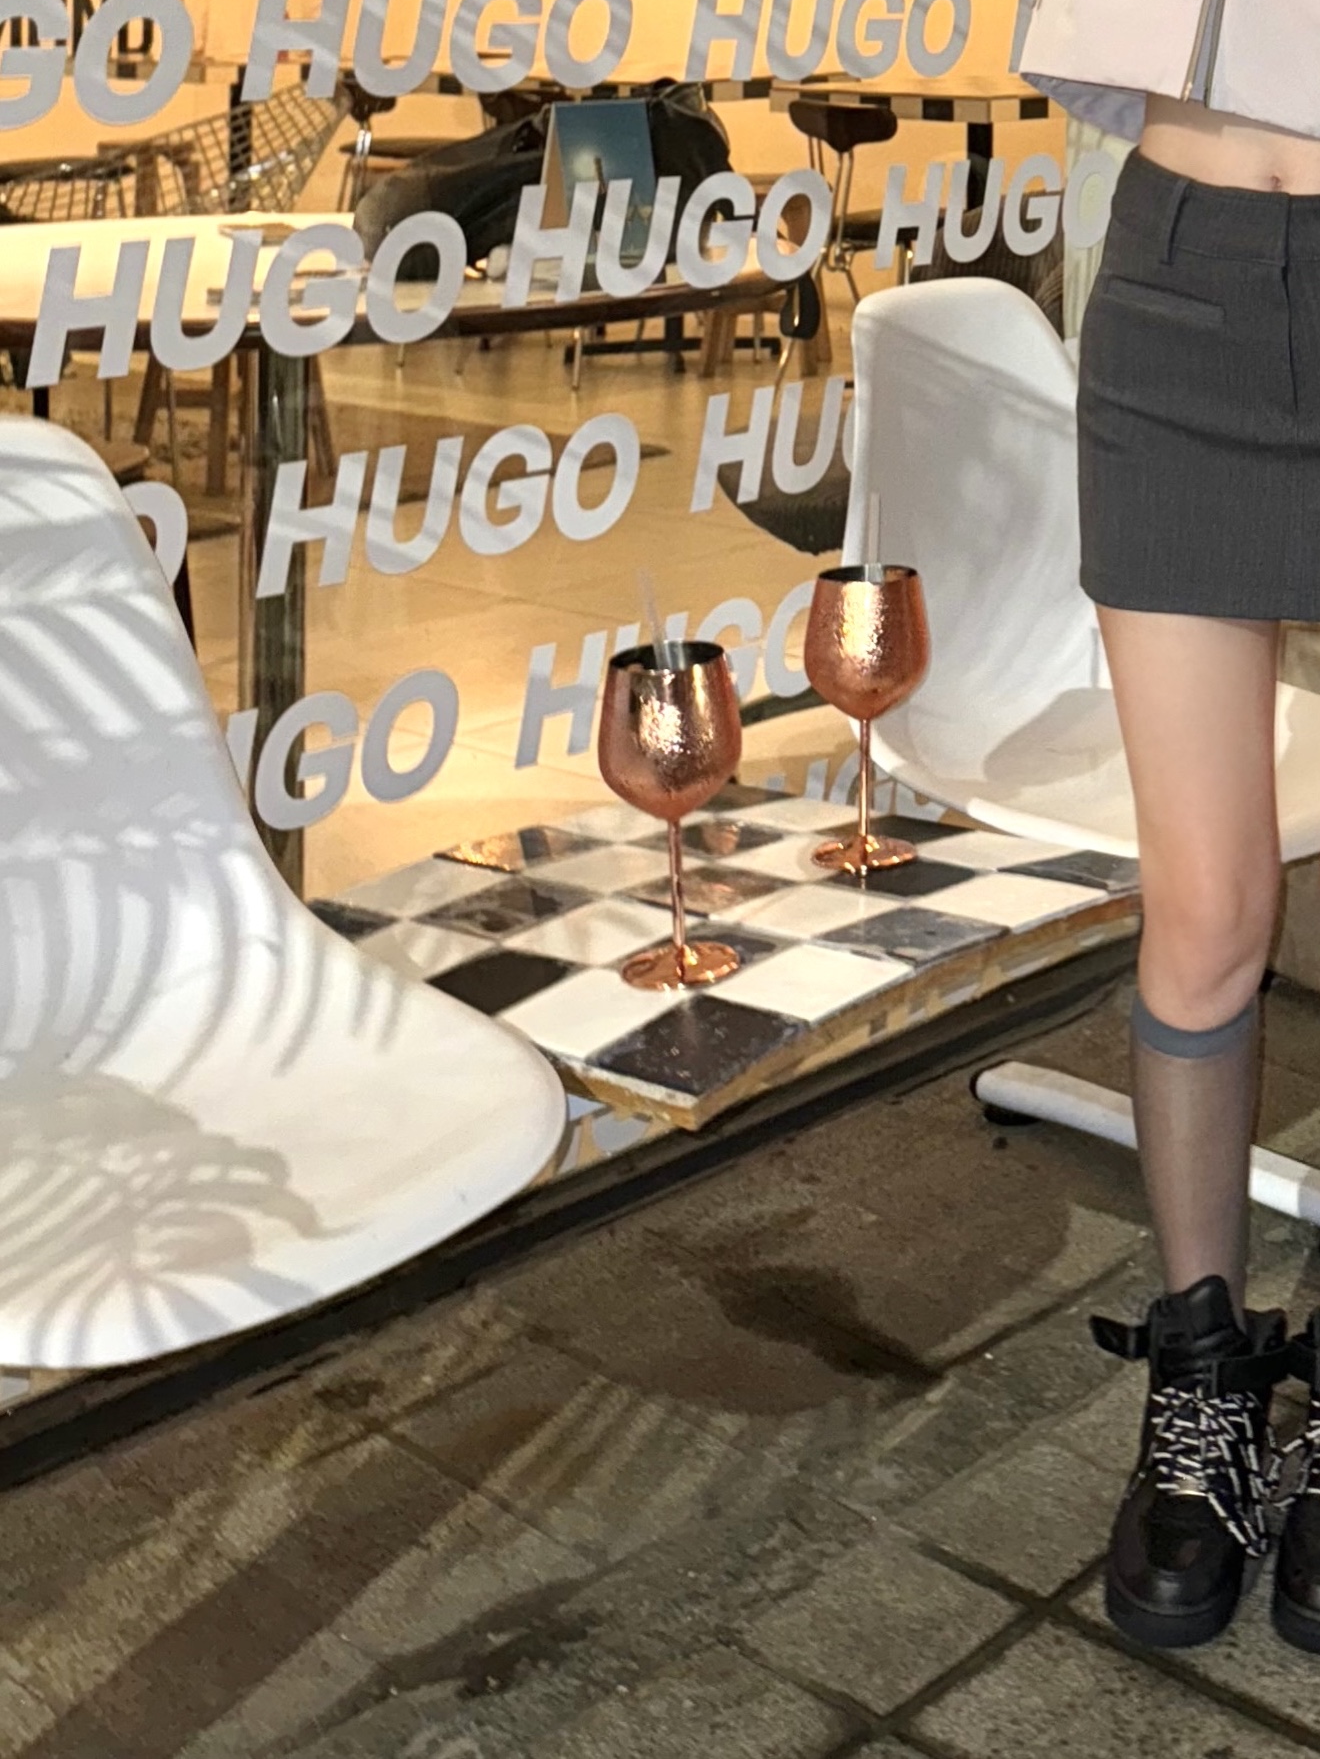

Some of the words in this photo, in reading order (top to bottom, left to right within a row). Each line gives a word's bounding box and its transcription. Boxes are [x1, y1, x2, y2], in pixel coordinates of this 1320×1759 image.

[25, 210, 467, 390] HUGO
[500, 167, 833, 310] HUGO
[873, 151, 1119, 270] HUGO
[256, 412, 641, 600] HUGO
[689, 376, 855, 514] HU
